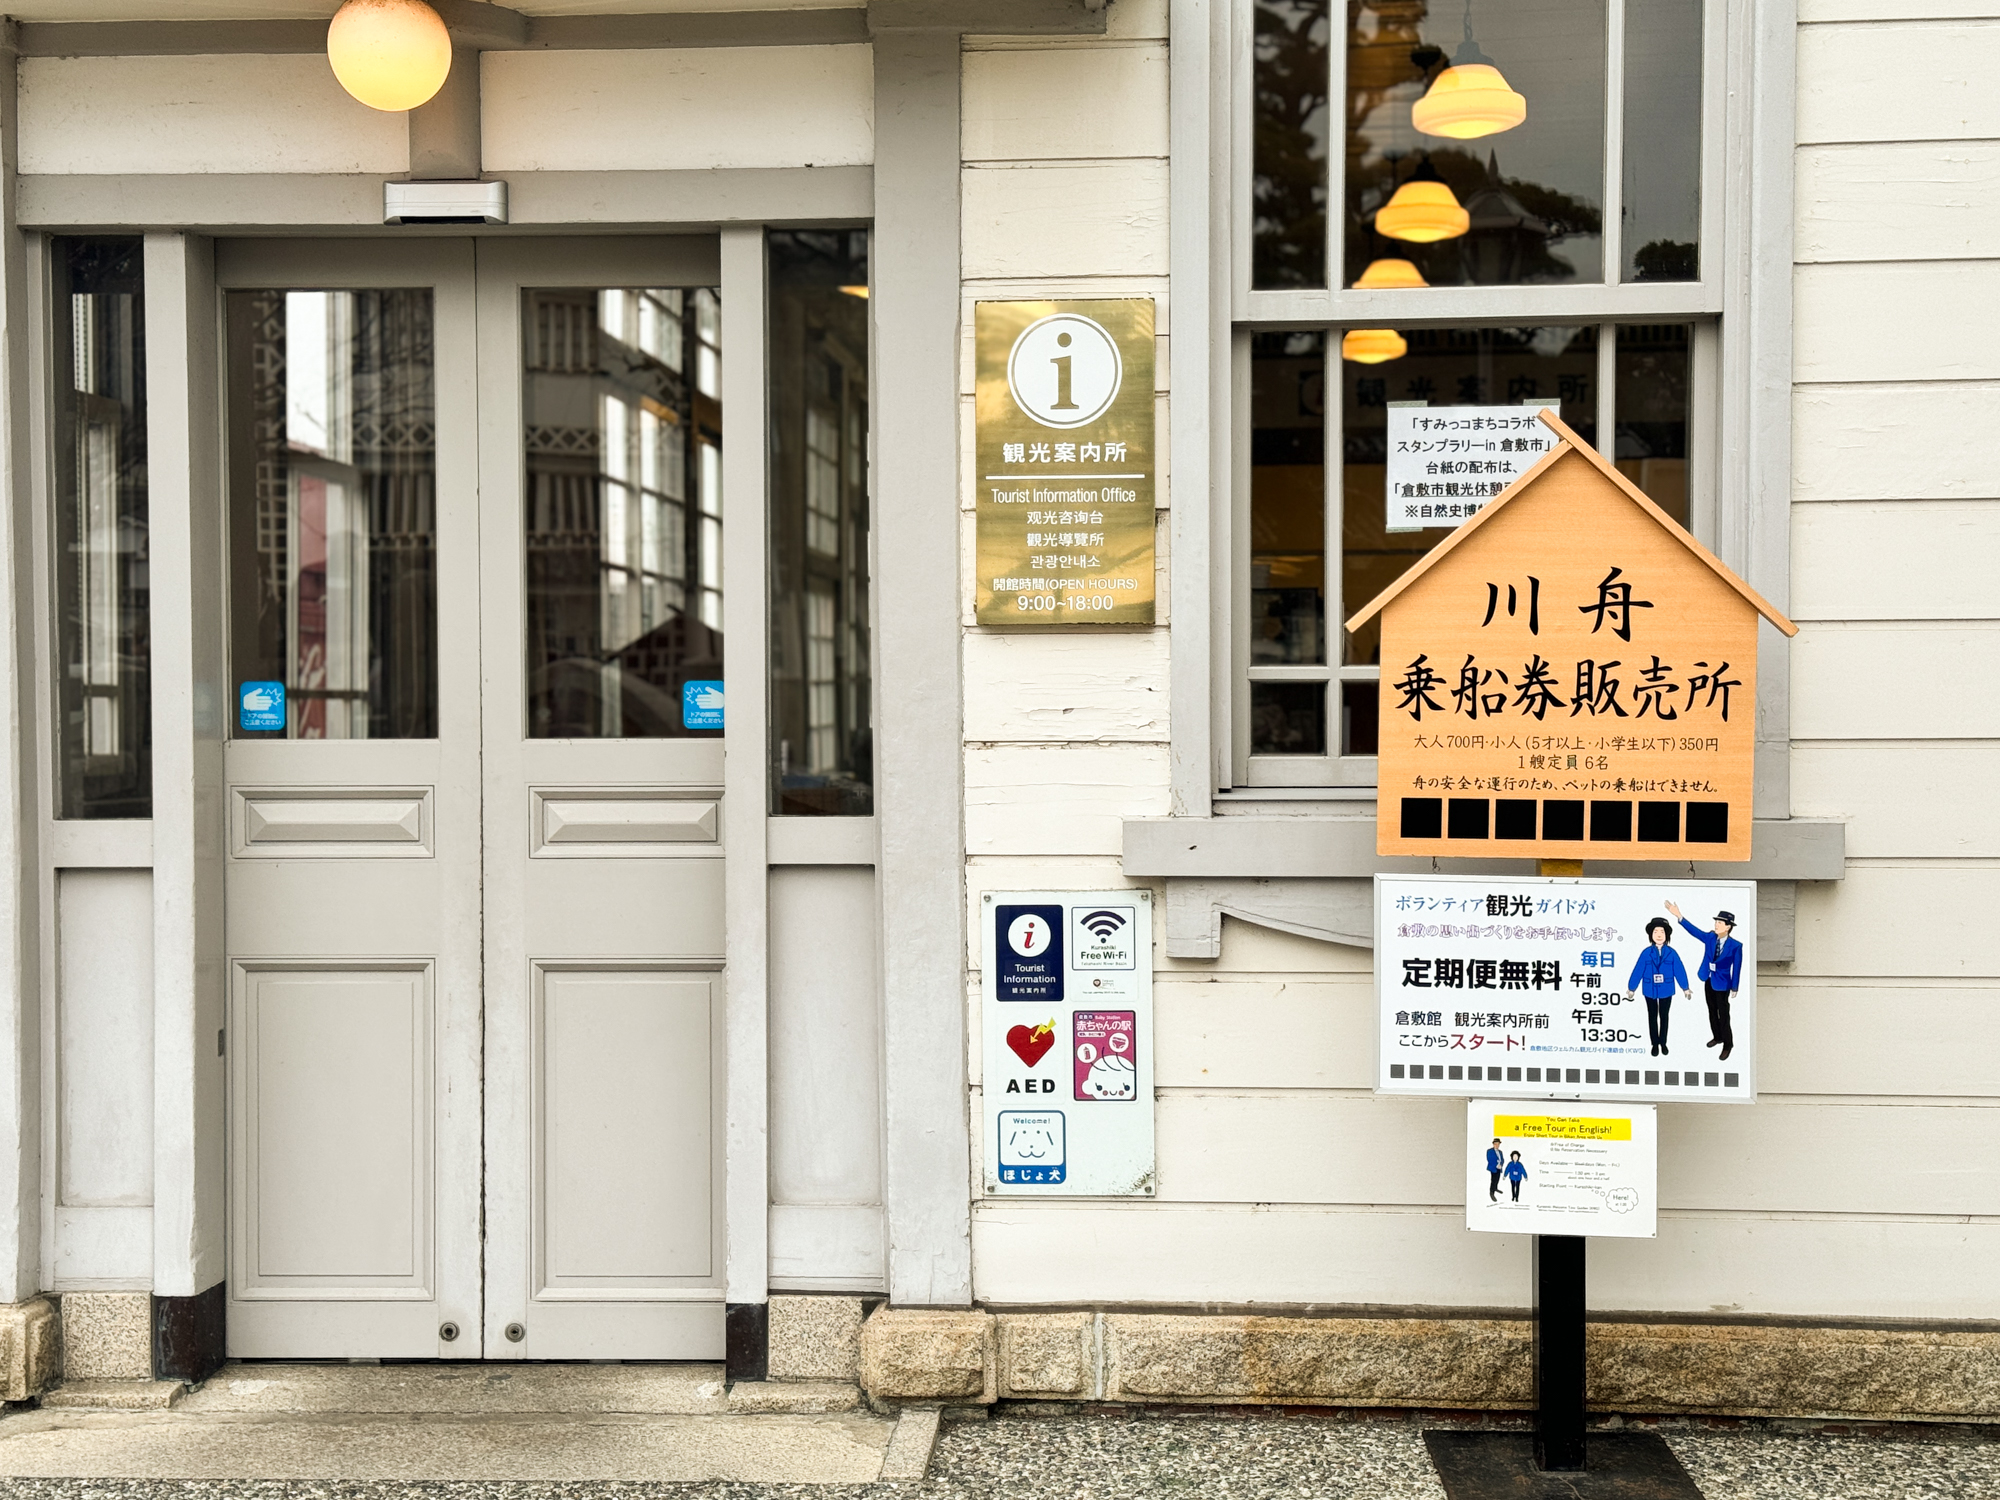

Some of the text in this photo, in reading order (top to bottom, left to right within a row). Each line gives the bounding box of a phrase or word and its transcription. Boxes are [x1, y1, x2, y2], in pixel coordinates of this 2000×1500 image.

[1412, 416, 1536, 431] 「すみっコまちコラボ
[1002, 442, 1128, 463] 観光案内所
[1397, 438, 1551, 453] スタンプラリーin 倉敷市」
[1426, 460, 1518, 475] 台紙の配布は、
[991, 487, 1136, 503] Tourist Information Office
[1026, 510, 1104, 525] 观光咨询台
[1405, 503, 1487, 518] ※自然史博
[1026, 533, 1104, 547] 觀光導覽所
[1030, 555, 1101, 569] 관광안내소
[1088, 578, 1138, 590] HOURS)
[1393, 652, 1743, 723] 乗船券販売所
[1080, 951, 1127, 960] Free Wi-Fi
[1581, 950, 1615, 968] 毎日
[1015, 963, 1045, 972] Tourist
[1402, 957, 1562, 991] 定期便無料
[1003, 975, 1056, 983] Information
[1570, 972, 1602, 988] 午前
[1395, 1010, 1550, 1029] 倉敷館 観光案内所前
[1571, 1008, 1603, 1025] 午后
[1076, 1020, 1132, 1031] 赤ちゃんの駅
[1006, 1079, 1056, 1093] AED
[1522, 1122, 1543, 1131] Free
[1545, 1123, 1566, 1132] Tour
[1569, 1124, 1576, 1132] in
[1579, 1125, 1612, 1135] English!
[1003, 1169, 1061, 1181] ほじょ犬
